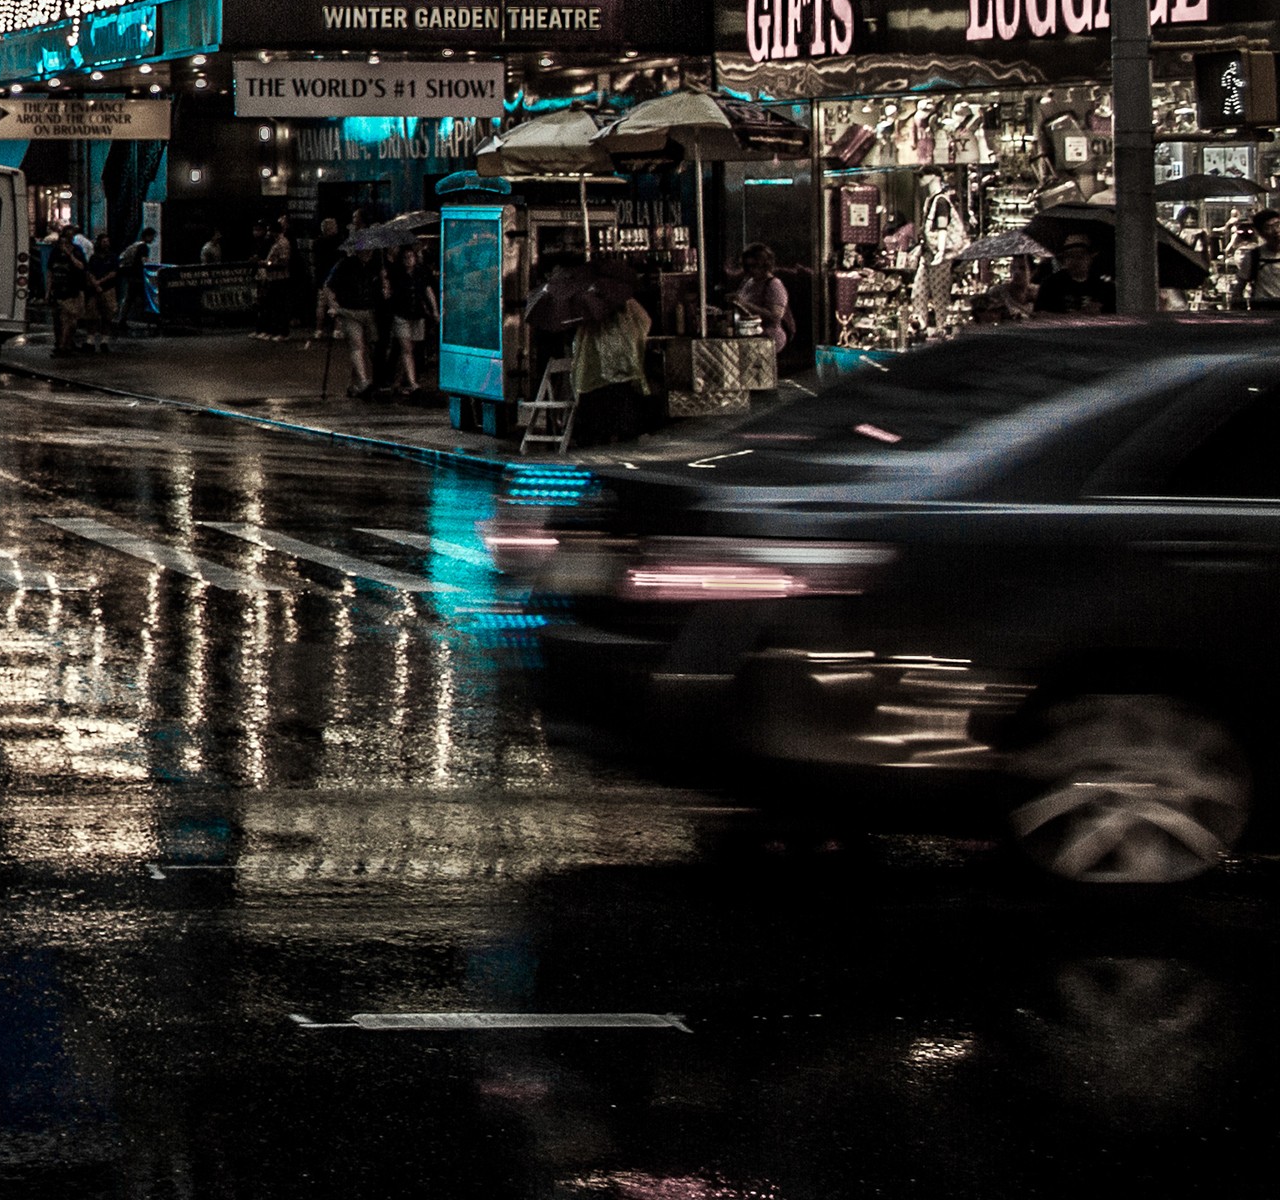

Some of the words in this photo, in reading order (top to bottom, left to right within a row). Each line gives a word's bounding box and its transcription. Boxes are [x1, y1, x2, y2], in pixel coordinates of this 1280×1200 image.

[323, 6, 408, 30] WINTER
[414, 6, 500, 30] GARDEN
[507, 7, 602, 31] THEATRE
[244, 77, 286, 99] THE
[291, 77, 387, 99] WORLD'S
[393, 78, 418, 99] #1
[425, 77, 497, 100] SHOW!
[16, 113, 61, 124] AROUND
[65, 113, 85, 124] THE
[88, 113, 133, 125] CORNER
[33, 125, 51, 136] ON
[52, 125, 113, 136] BROADWAY
